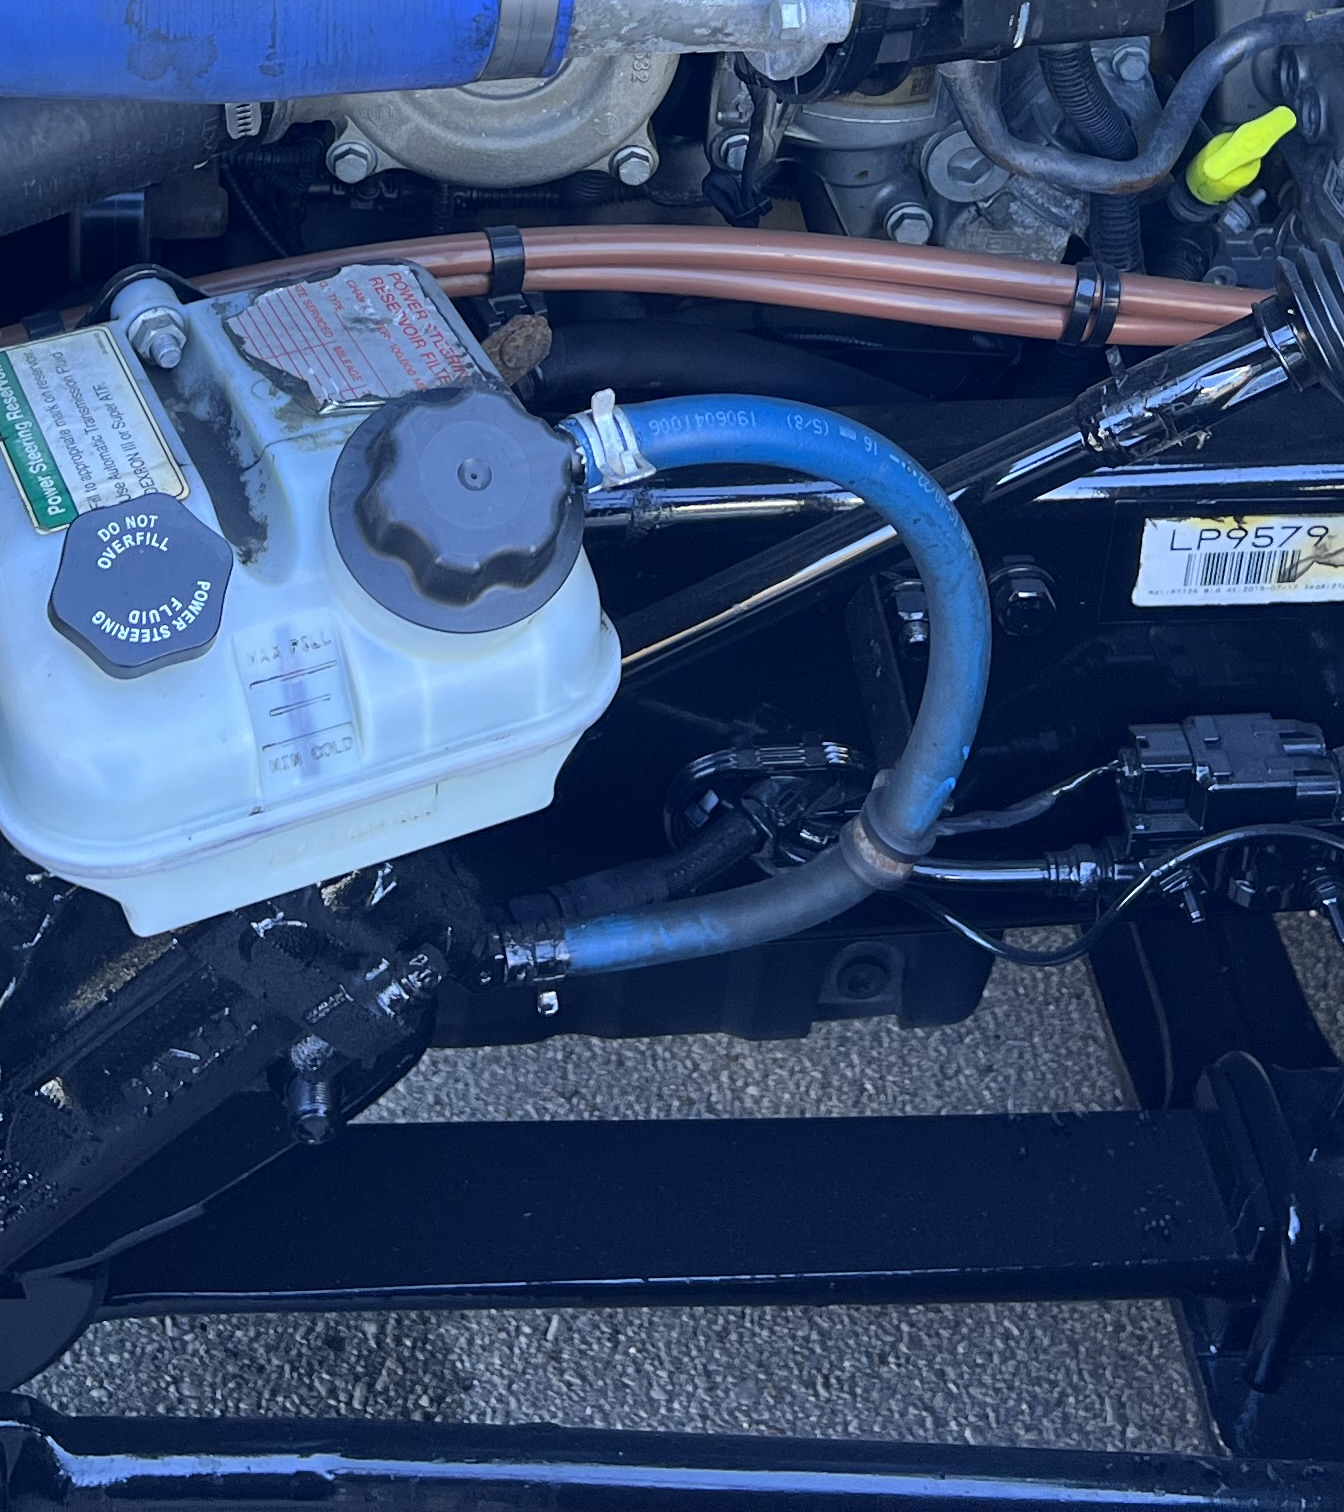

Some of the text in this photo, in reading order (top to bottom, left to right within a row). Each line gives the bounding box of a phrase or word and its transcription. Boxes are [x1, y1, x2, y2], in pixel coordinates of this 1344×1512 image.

[388, 272, 428, 320] POWER
[304, 299, 334, 338] SERVICED
[333, 346, 365, 382] MILEAGE
[41, 390, 55, 405] on
[64, 374, 98, 435] Transmission
[45, 404, 66, 427] mark
[106, 403, 126, 430] Super
[15, 421, 48, 474] Steering
[119, 430, 132, 442] or
[864, 436, 878, 456] 16
[59, 429, 92, 486] appropriate
[92, 435, 122, 482] Automatic
[126, 451, 157, 495] DEXRON
[37, 475, 66, 516] Power
[84, 482, 98, 494] to
[114, 482, 131, 502] Use
[97, 514, 158, 542] DO NOT
[1170, 525, 1330, 552] LP9579
[97, 532, 169, 569] OVERFILL
[91, 580, 211, 643] POWER STEERING
[128, 597, 182, 625] FLUID
[311, 736, 353, 760] COLD
